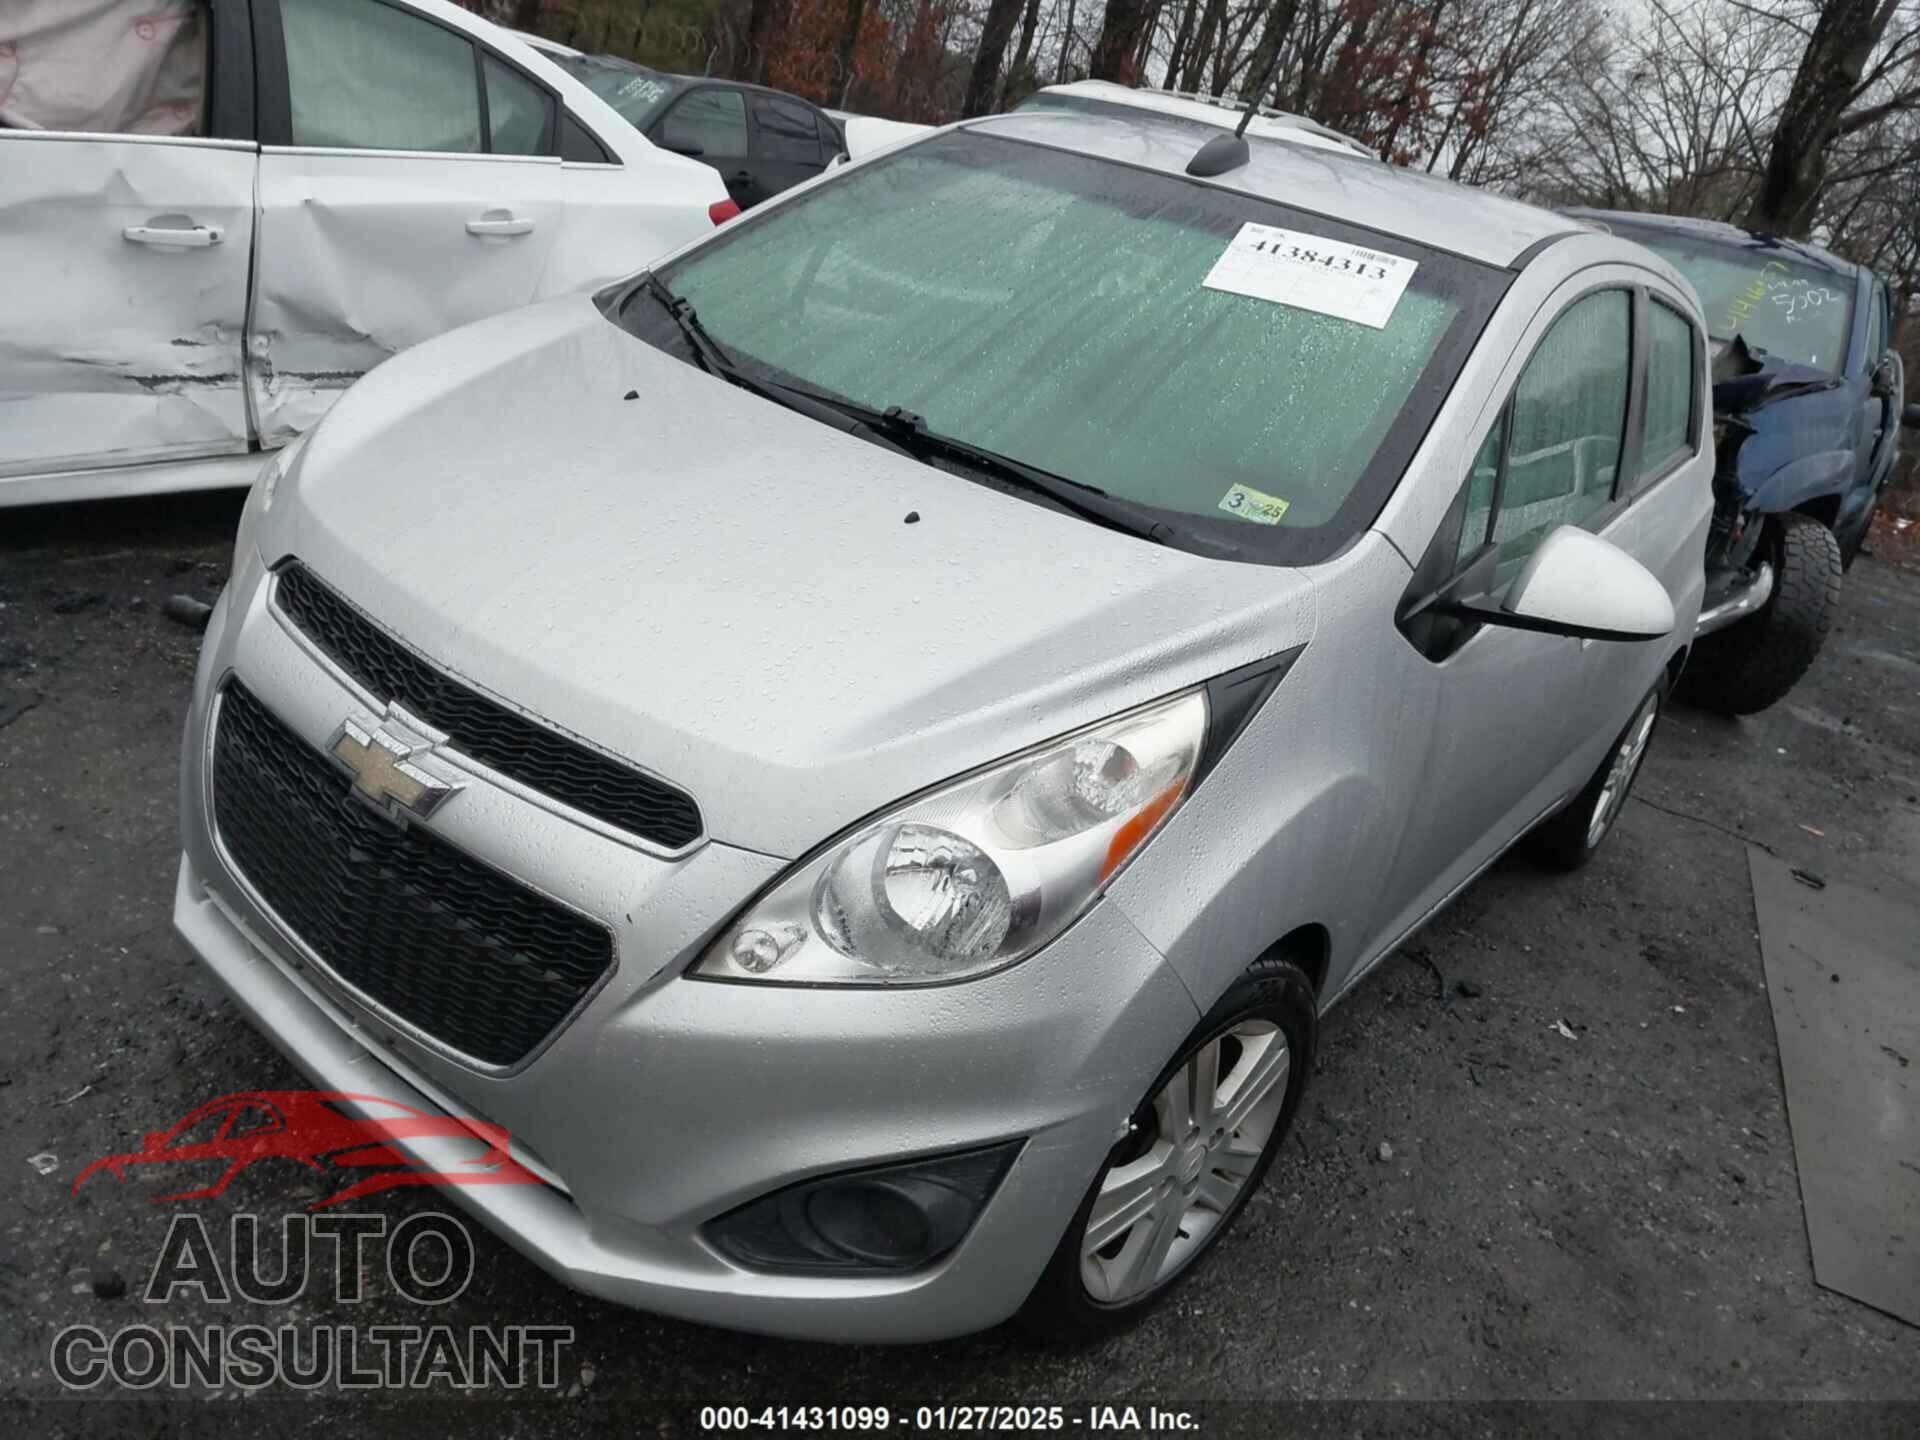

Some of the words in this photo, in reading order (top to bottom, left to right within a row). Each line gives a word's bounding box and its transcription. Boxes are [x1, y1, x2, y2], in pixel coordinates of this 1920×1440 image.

[1250, 240, 1387, 280] 41384313
[1228, 492, 1246, 508] 3
[1263, 503, 1284, 518] 25
